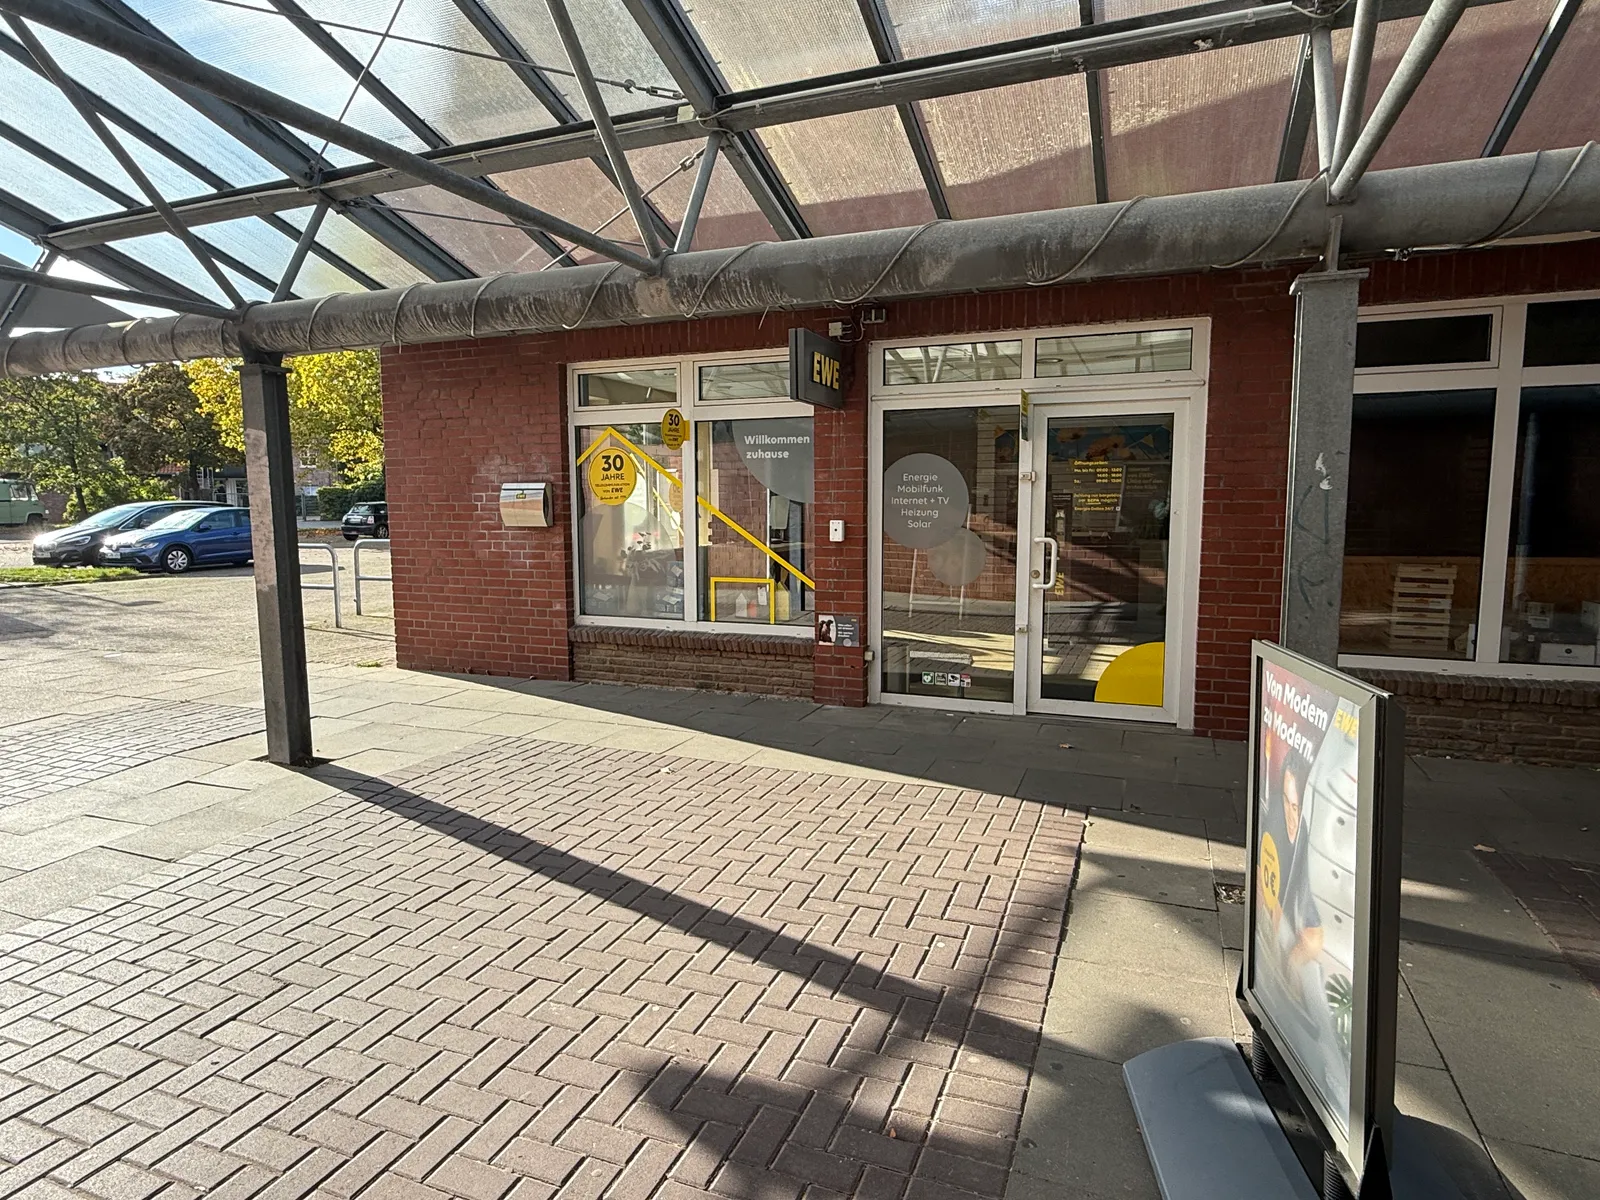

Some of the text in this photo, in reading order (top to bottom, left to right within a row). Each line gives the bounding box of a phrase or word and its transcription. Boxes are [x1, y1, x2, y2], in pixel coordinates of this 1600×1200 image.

[813, 351, 840, 390] EWE
[668, 413, 680, 427] 30
[744, 434, 810, 445] Willkommen
[746, 448, 790, 459] zuhause
[601, 454, 624, 472] 30
[601, 473, 625, 481] JAHRE
[902, 472, 938, 483] Energie
[897, 484, 943, 493] Mobilfunk
[891, 496, 928, 505] Internet
[937, 496, 950, 505] TV
[901, 508, 939, 519] Heizung
[907, 519, 932, 528] Solar
[1055, 571, 1065, 596] EWE
[1266, 670, 1329, 732] Von Modem
[1334, 707, 1358, 740] EWE
[1273, 710, 1315, 764] Modern.
